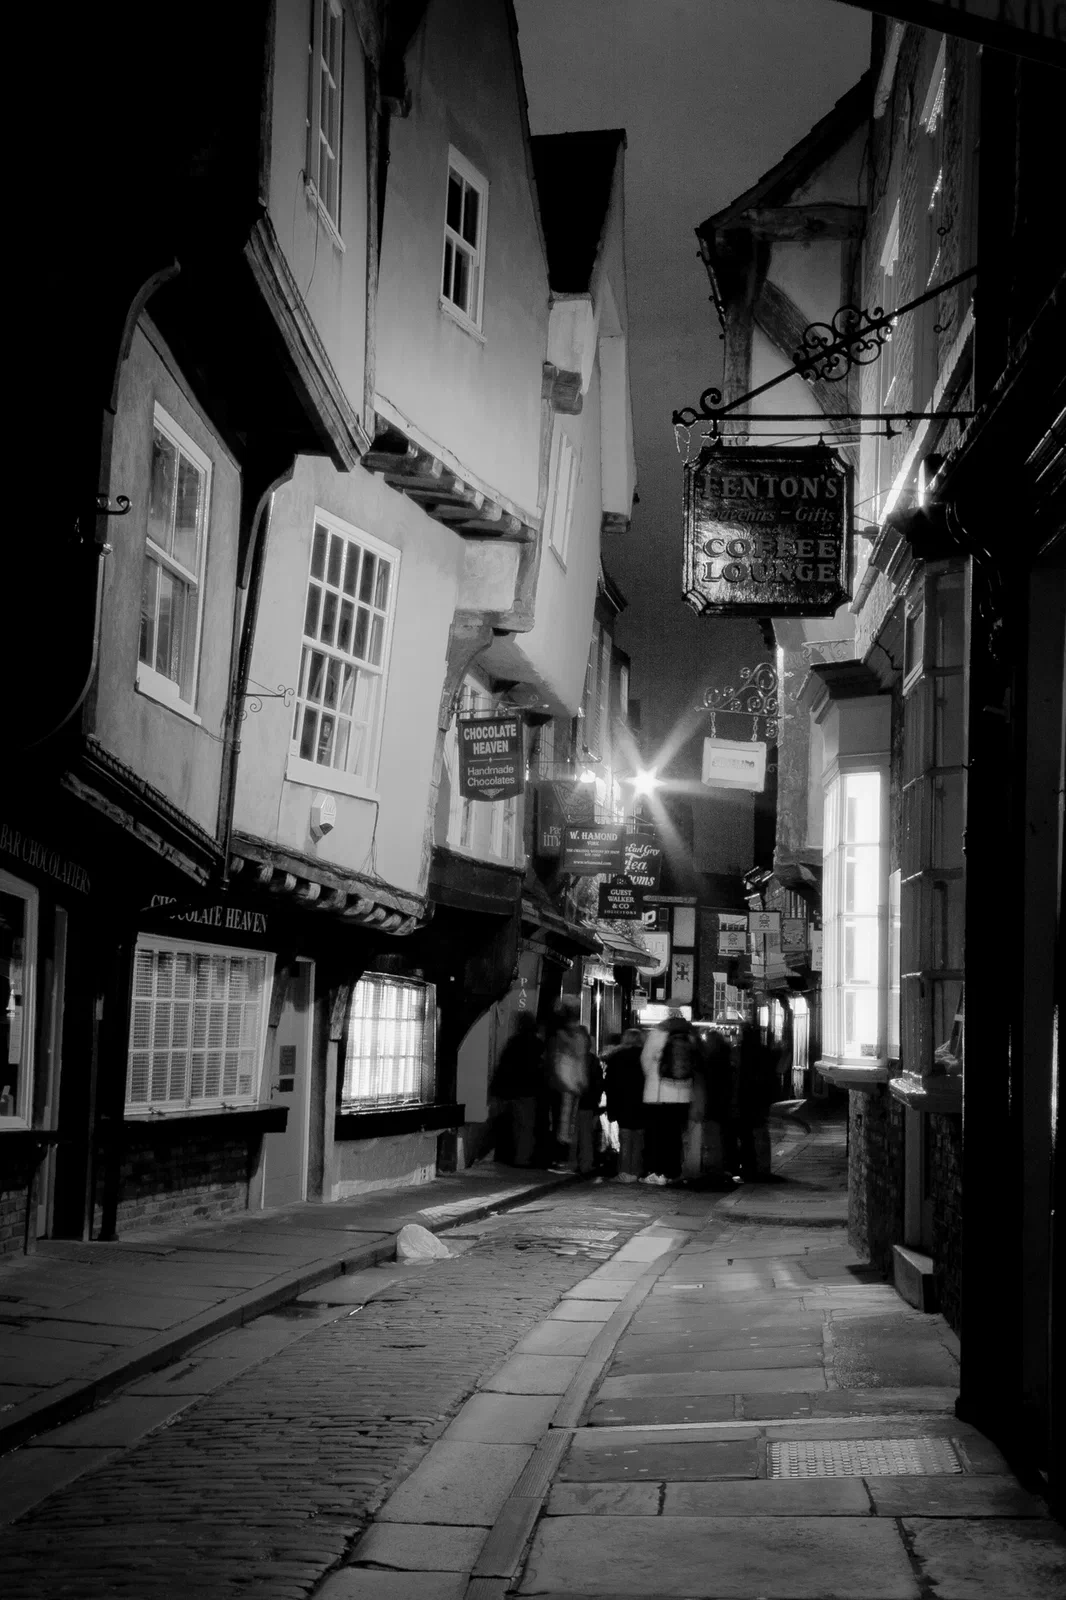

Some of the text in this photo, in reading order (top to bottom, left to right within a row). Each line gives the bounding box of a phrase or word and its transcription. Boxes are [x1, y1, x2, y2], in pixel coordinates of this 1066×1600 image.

[702, 475, 838, 499] FENTON'S
[795, 506, 836, 522] Gifts
[703, 538, 837, 559] COFFEE
[701, 561, 836, 583] LOUNGE
[463, 724, 517, 741] CHOCOLATE
[472, 740, 509, 755] HEAVEN
[467, 765, 514, 776] Handmade
[467, 776, 515, 787] Chocolates
[569, 830, 618, 841] W. HAMOND
[628, 843, 644, 853] Earl
[22, 837, 91, 896] CHOCOLATIERS
[624, 852, 648, 870] Tea
[225, 907, 268, 933] HEAVEN
